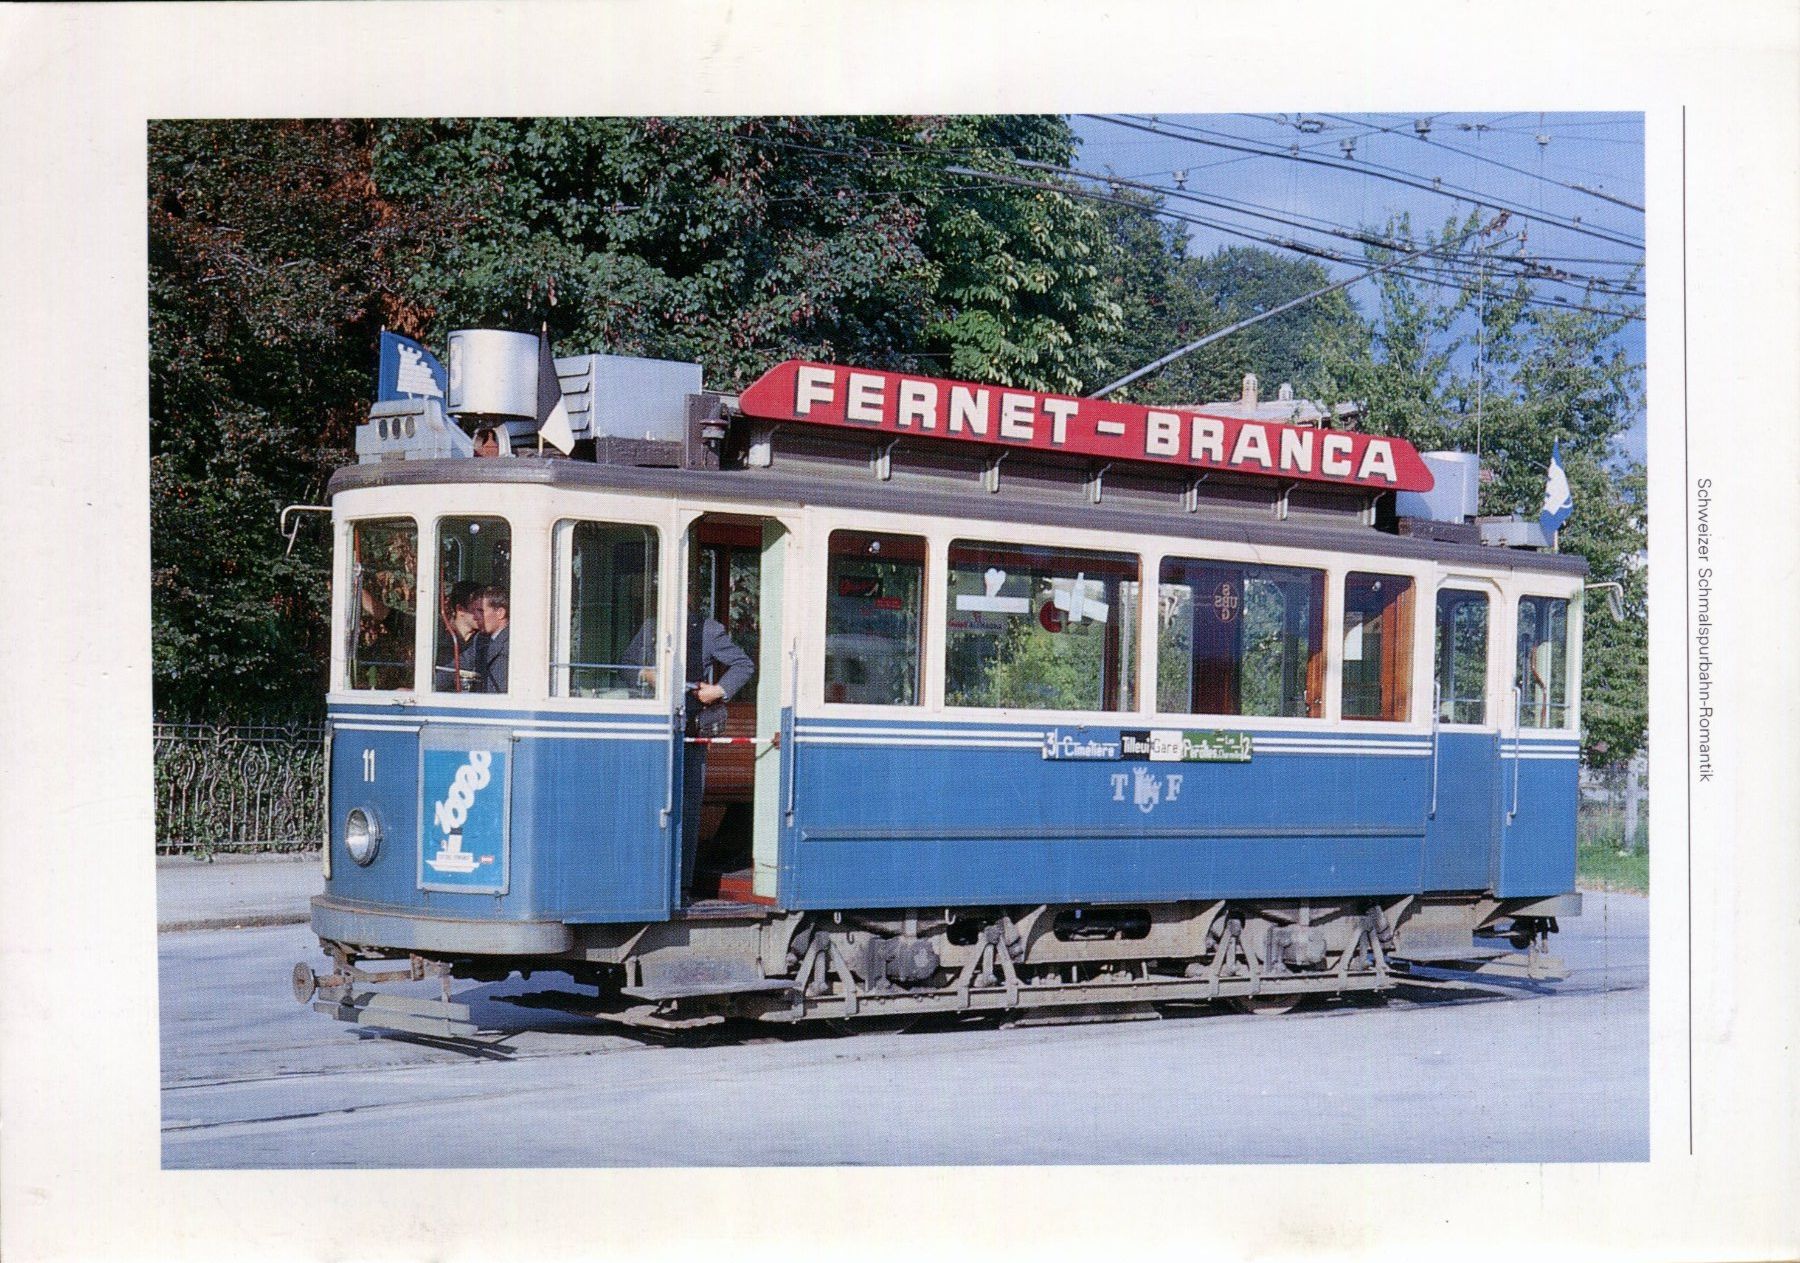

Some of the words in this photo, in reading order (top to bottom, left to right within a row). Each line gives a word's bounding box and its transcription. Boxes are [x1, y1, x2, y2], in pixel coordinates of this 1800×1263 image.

[796, 366, 1079, 444] FERNET
[1145, 411, 1398, 482] BRANCA
[1153, 738, 1179, 754] Gare
[362, 749, 376, 782] 11
[1111, 773, 1129, 801] T
[1166, 774, 1183, 801] F
